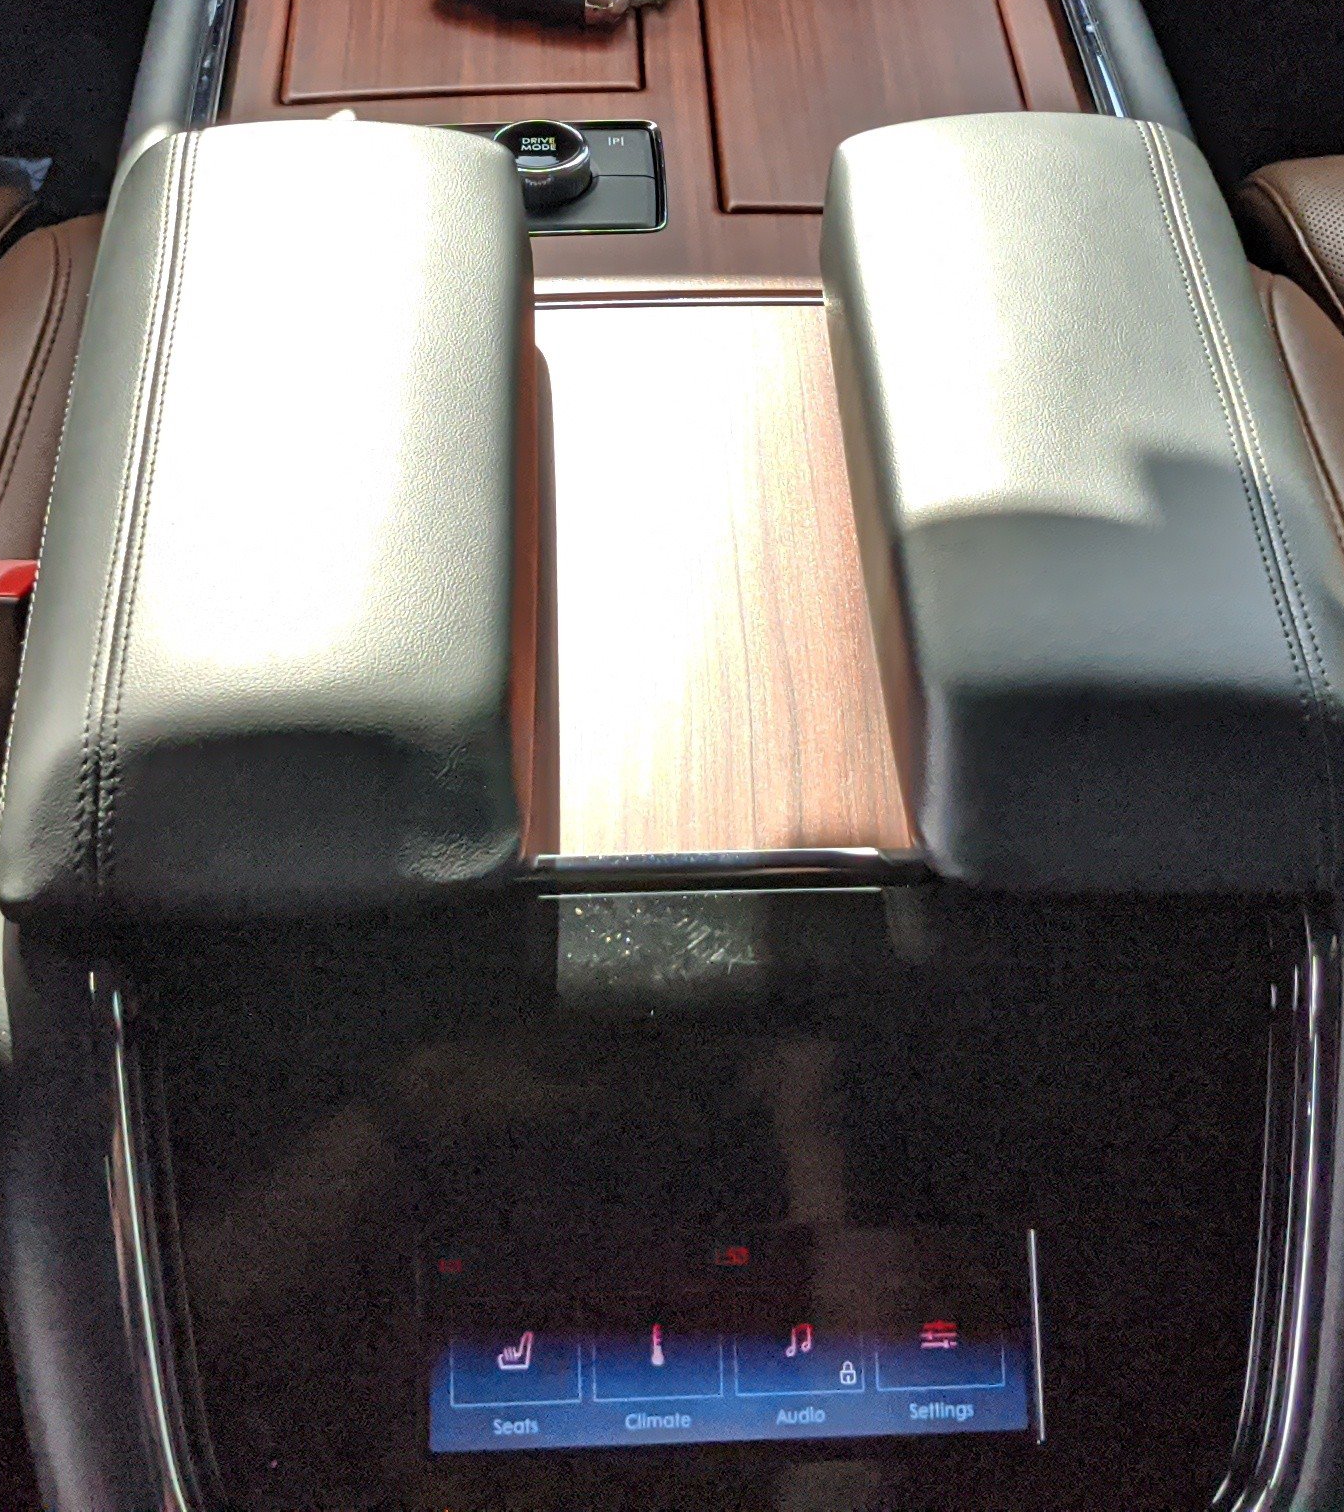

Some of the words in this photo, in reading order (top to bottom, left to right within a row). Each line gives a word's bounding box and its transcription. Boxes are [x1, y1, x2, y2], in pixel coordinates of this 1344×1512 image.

[521, 136, 556, 145] DRIVE
[624, 1410, 692, 1432] Climate
[776, 1404, 826, 1425] Audio
[908, 1401, 975, 1423] Settings
[492, 1417, 539, 1436] Seats
